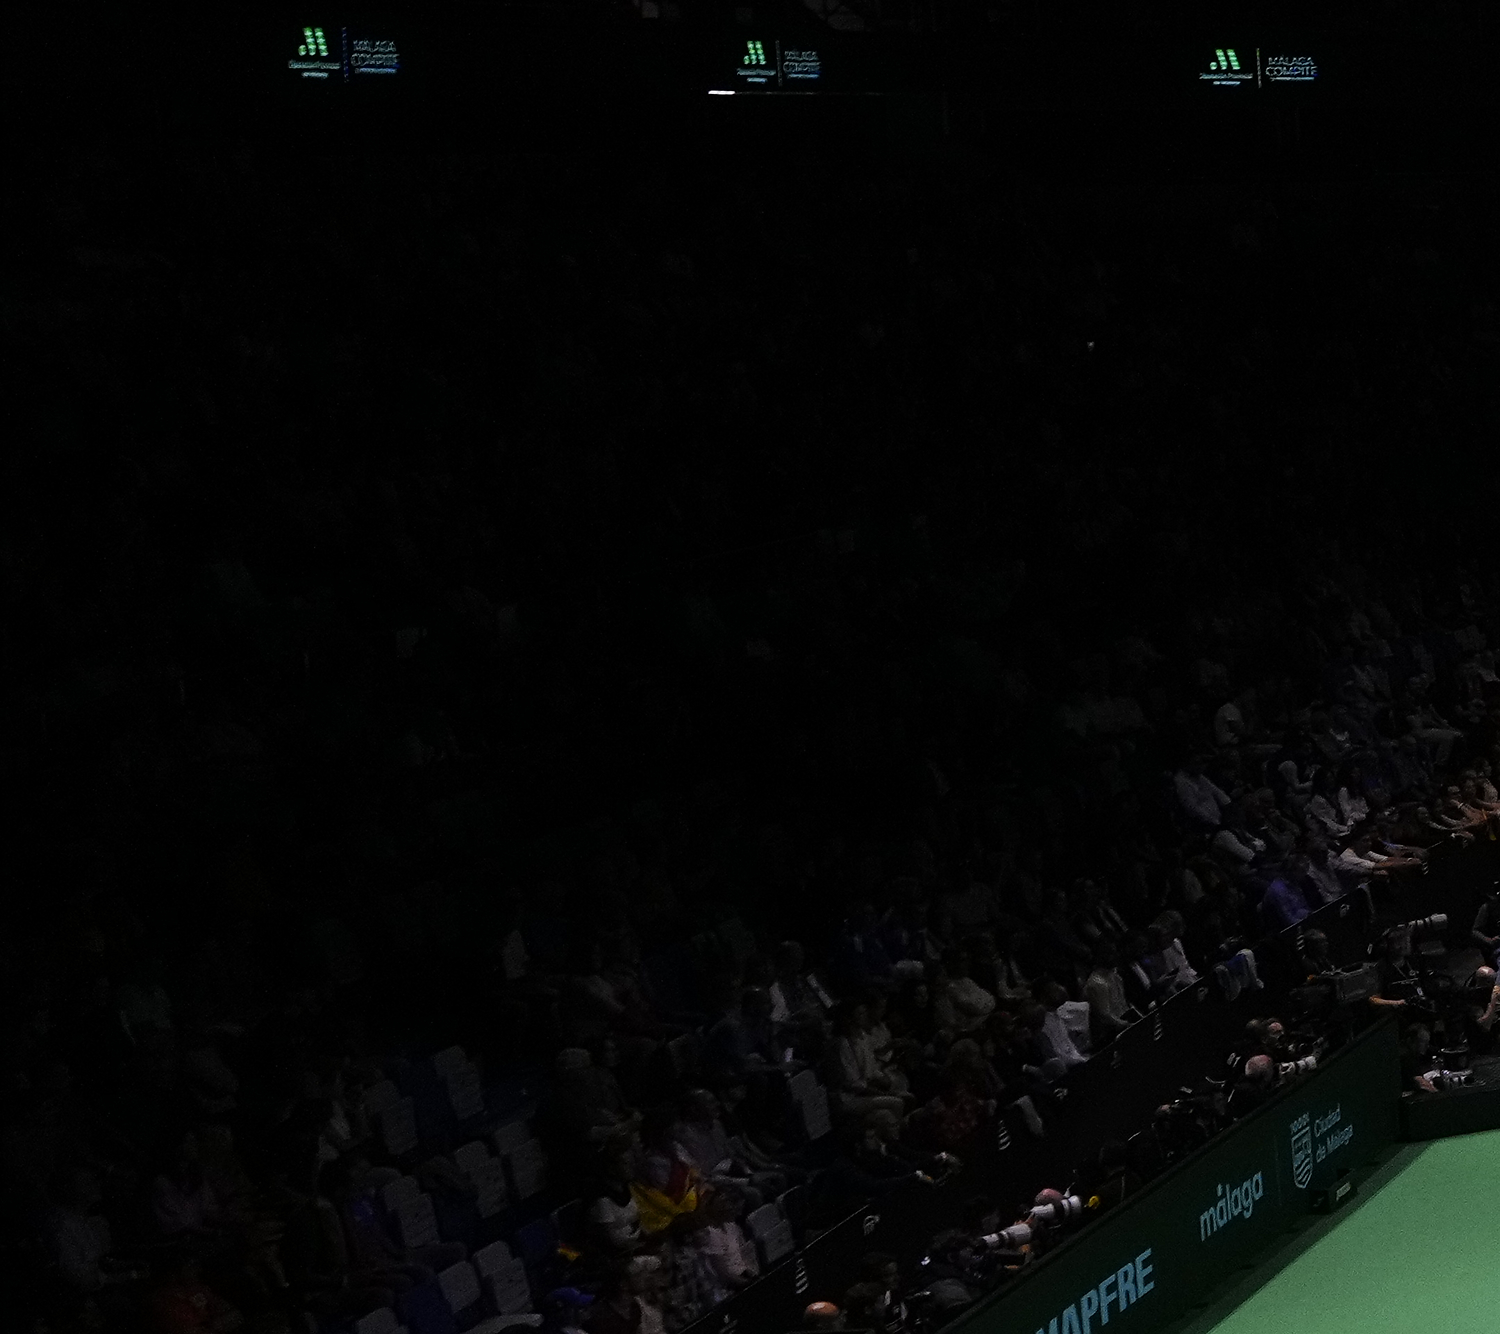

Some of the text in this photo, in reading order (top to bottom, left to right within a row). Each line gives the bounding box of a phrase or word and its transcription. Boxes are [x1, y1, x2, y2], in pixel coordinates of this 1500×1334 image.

[1314, 1103, 1341, 1138] Ciudad
[1316, 1124, 1353, 1163] de Málaga
[1200, 1170, 1263, 1242] málaga
